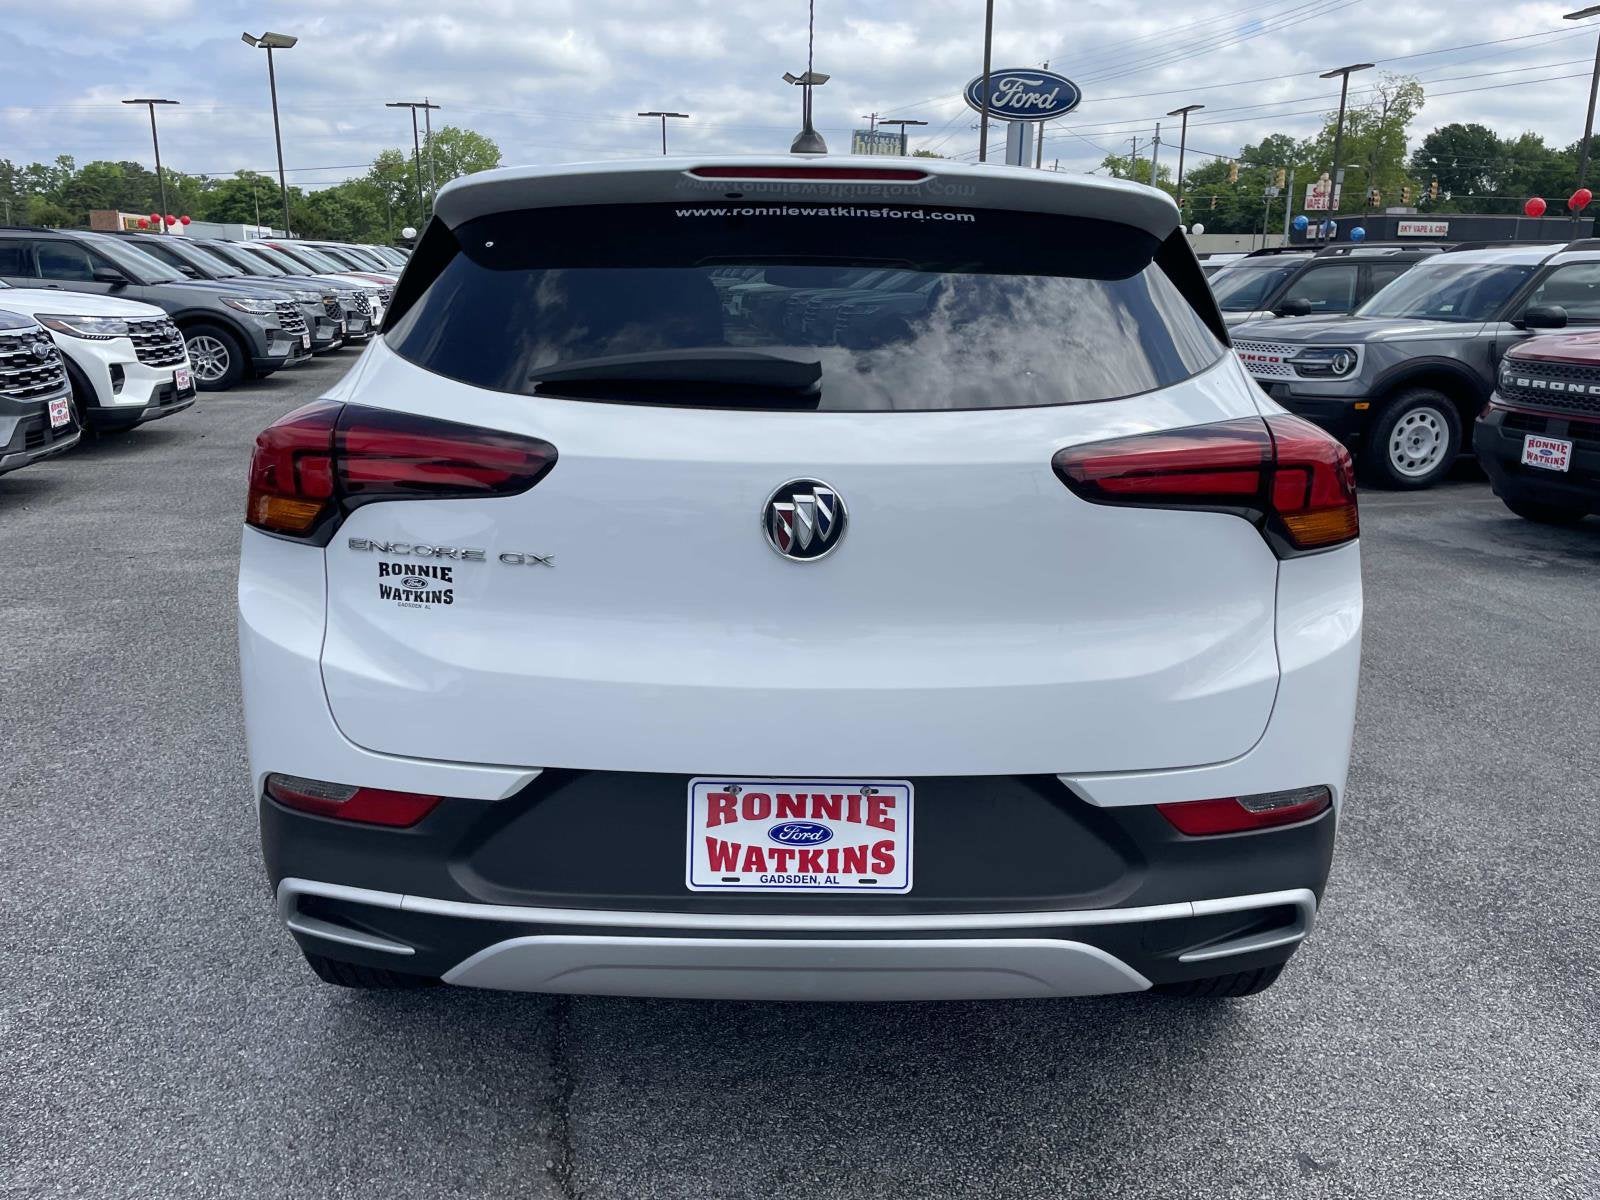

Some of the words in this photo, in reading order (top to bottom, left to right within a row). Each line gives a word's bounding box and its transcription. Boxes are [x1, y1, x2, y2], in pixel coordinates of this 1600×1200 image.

[992, 77, 1060, 110] Ford
[675, 205, 976, 222] www.ronniewatkinsford.com
[1413, 224, 1428, 233] VAPE
[1239, 353, 1280, 363] ONCO
[1516, 378, 1600, 395] BRONC
[1527, 439, 1568, 455] RONNIE
[1526, 450, 1566, 466] WATKINS
[348, 537, 487, 561] ENCORE
[498, 551, 555, 568] GX
[378, 561, 453, 583] RONNIE
[379, 583, 454, 605] WATKINS
[705, 792, 896, 833] RONNIE
[705, 835, 896, 875] WATKINS
[759, 874, 822, 886] GADSDEN,
[824, 875, 840, 885] AL
